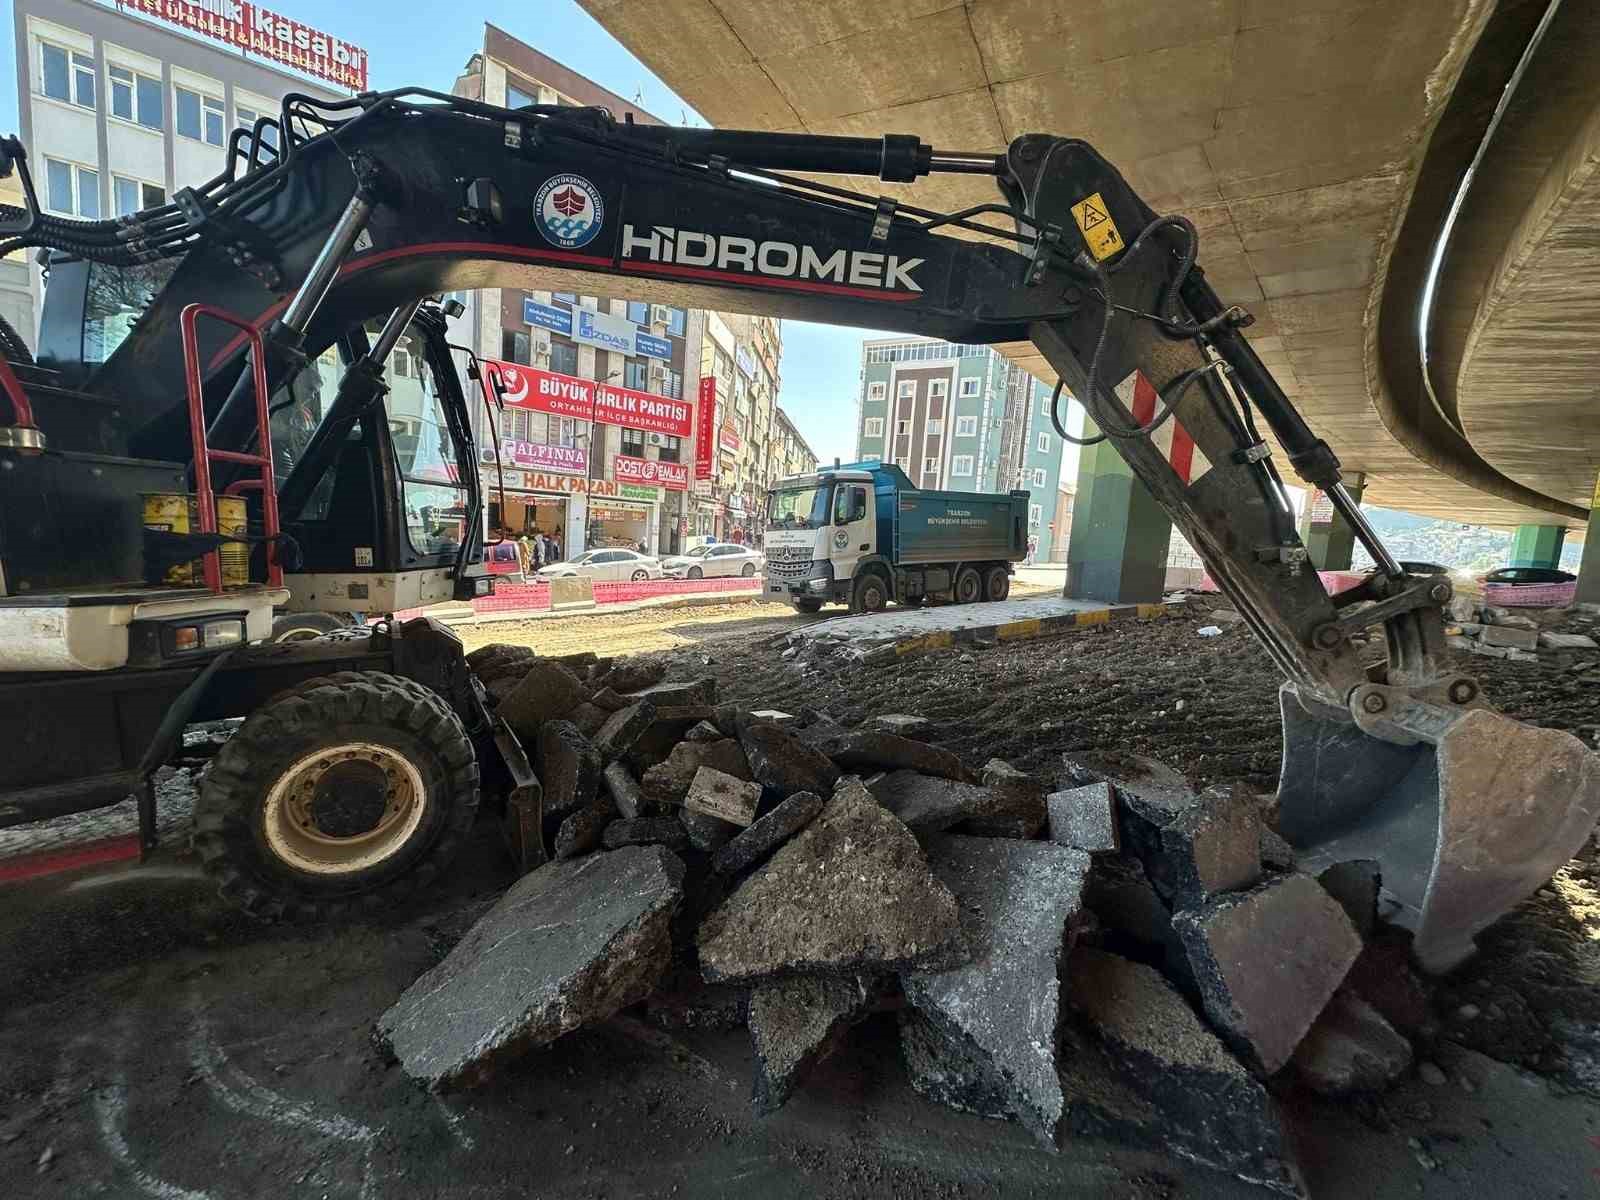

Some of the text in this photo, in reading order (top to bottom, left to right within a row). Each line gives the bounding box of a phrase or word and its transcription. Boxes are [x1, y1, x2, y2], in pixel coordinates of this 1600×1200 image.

[536, 187, 549, 216] TRABZON
[539, 377, 589, 402] BÜYÜK
[640, 400, 687, 422] PARTİSİ
[516, 443, 586, 463] ALFINNA
[616, 459, 643, 474] DOST
[658, 464, 687, 481] EMLAK
[523, 472, 565, 490] HALK
[569, 477, 619, 496] PAZARI
